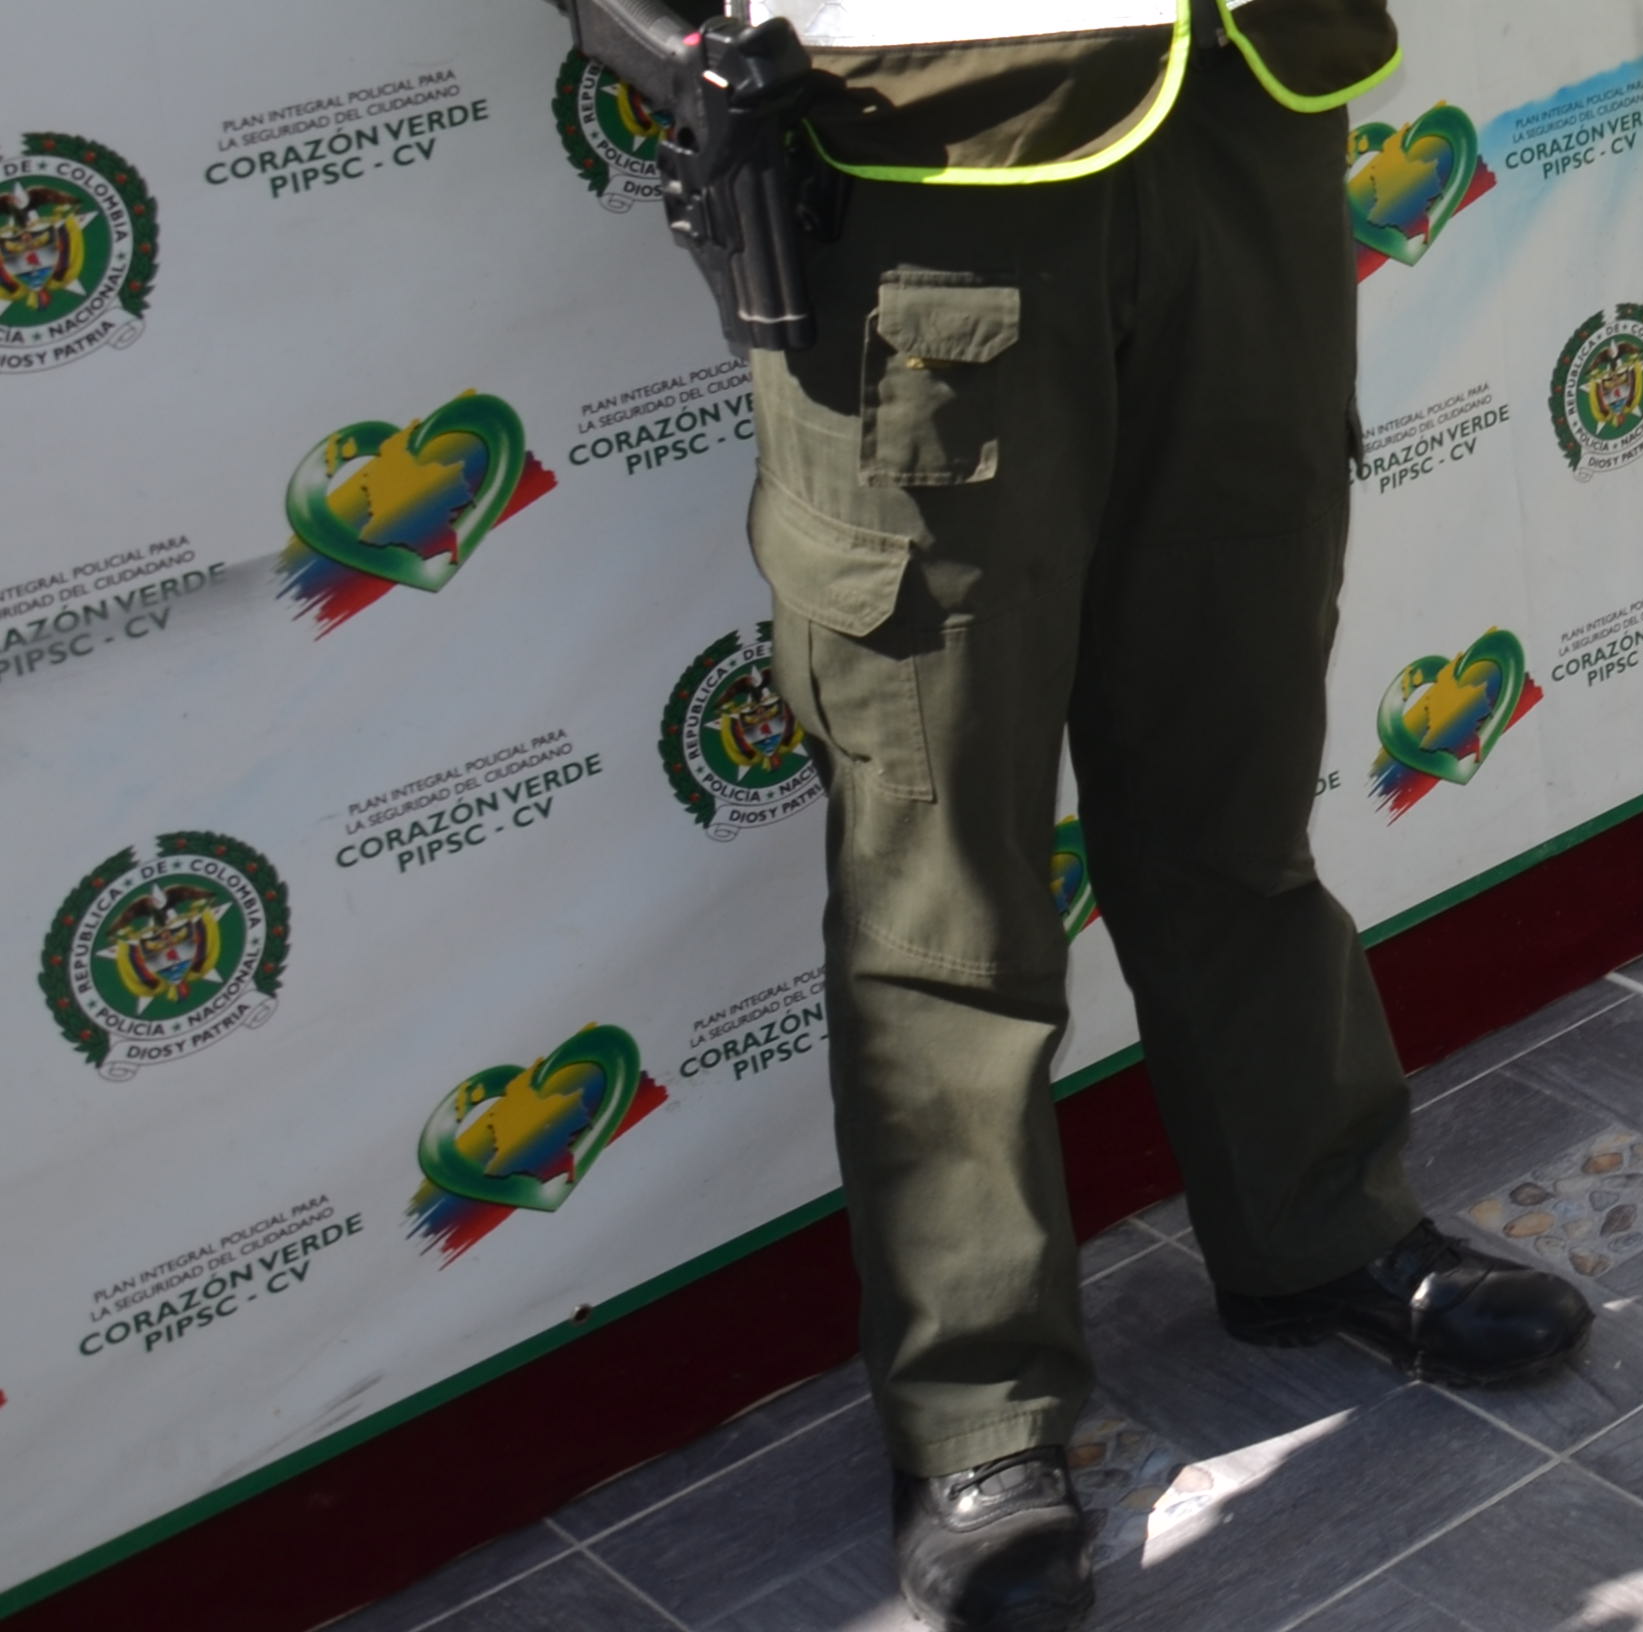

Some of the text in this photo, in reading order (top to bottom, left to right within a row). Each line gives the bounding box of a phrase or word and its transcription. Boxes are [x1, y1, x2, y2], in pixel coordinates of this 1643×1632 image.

[218, 84, 460, 152] LA SEGURIDAD DEL CIUDADANO
[223, 68, 455, 133] PLAN INTEGRAL POLICIAL PARA
[1513, 131, 1523, 144] LA
[1526, 113, 1576, 139] SEGURIDAD
[1580, 108, 1595, 122] DEL
[1515, 112, 1538, 129] PLAN
[1542, 97, 1584, 120] INTEGRAL
[1588, 84, 1625, 106] POLICIAL
[205, 99, 489, 187] CORAZÓN VERDE
[270, 138, 435, 198] PIPSC CV
[1506, 123, 1604, 170] CORAZÓN
[1543, 133, 1636, 178] PIPSC CV
[568, 402, 720, 467] CORAZÓN
[627, 432, 709, 475] PIPSC
[1447, 403, 1510, 444] VERDE
[1380, 437, 1476, 494] PIPSC CV
[113, 562, 228, 616] VERDE
[125, 606, 170, 641] CV
[1559, 644, 1569, 657] LA
[1572, 621, 1621, 651] SEGURIDAD
[1624, 614, 1638, 628] DEL
[1561, 625, 1584, 643] PLAN
[1587, 605, 1628, 631] INTEGRAL
[1588, 649, 1639, 687] PIPSC
[346, 741, 573, 835] LA SEGURIDAD DEL CIUDADANO
[349, 727, 567, 816] PLAN INTEGRAL POLICIAL PARA
[336, 752, 602, 870] CORAZÓN VERDE
[398, 796, 553, 873] PIPSC CV
[141, 861, 168, 880] DE
[190, 859, 262, 929] COLOMBIA
[188, 952, 260, 1026] NACIONAL
[191, 1003, 251, 1047] PATRIA
[680, 1002, 822, 1080] CORAZÓN
[734, 1031, 811, 1081] PIPSC
[91, 1205, 334, 1324] LA SEGURIDAD DEL CIUDADANO
[95, 1191, 329, 1305] PLAN INTEGRAL POLICIAL PARA
[79, 1212, 362, 1358] CORAZÓN VERDE
[145, 1260, 309, 1353] PIPSC CV
